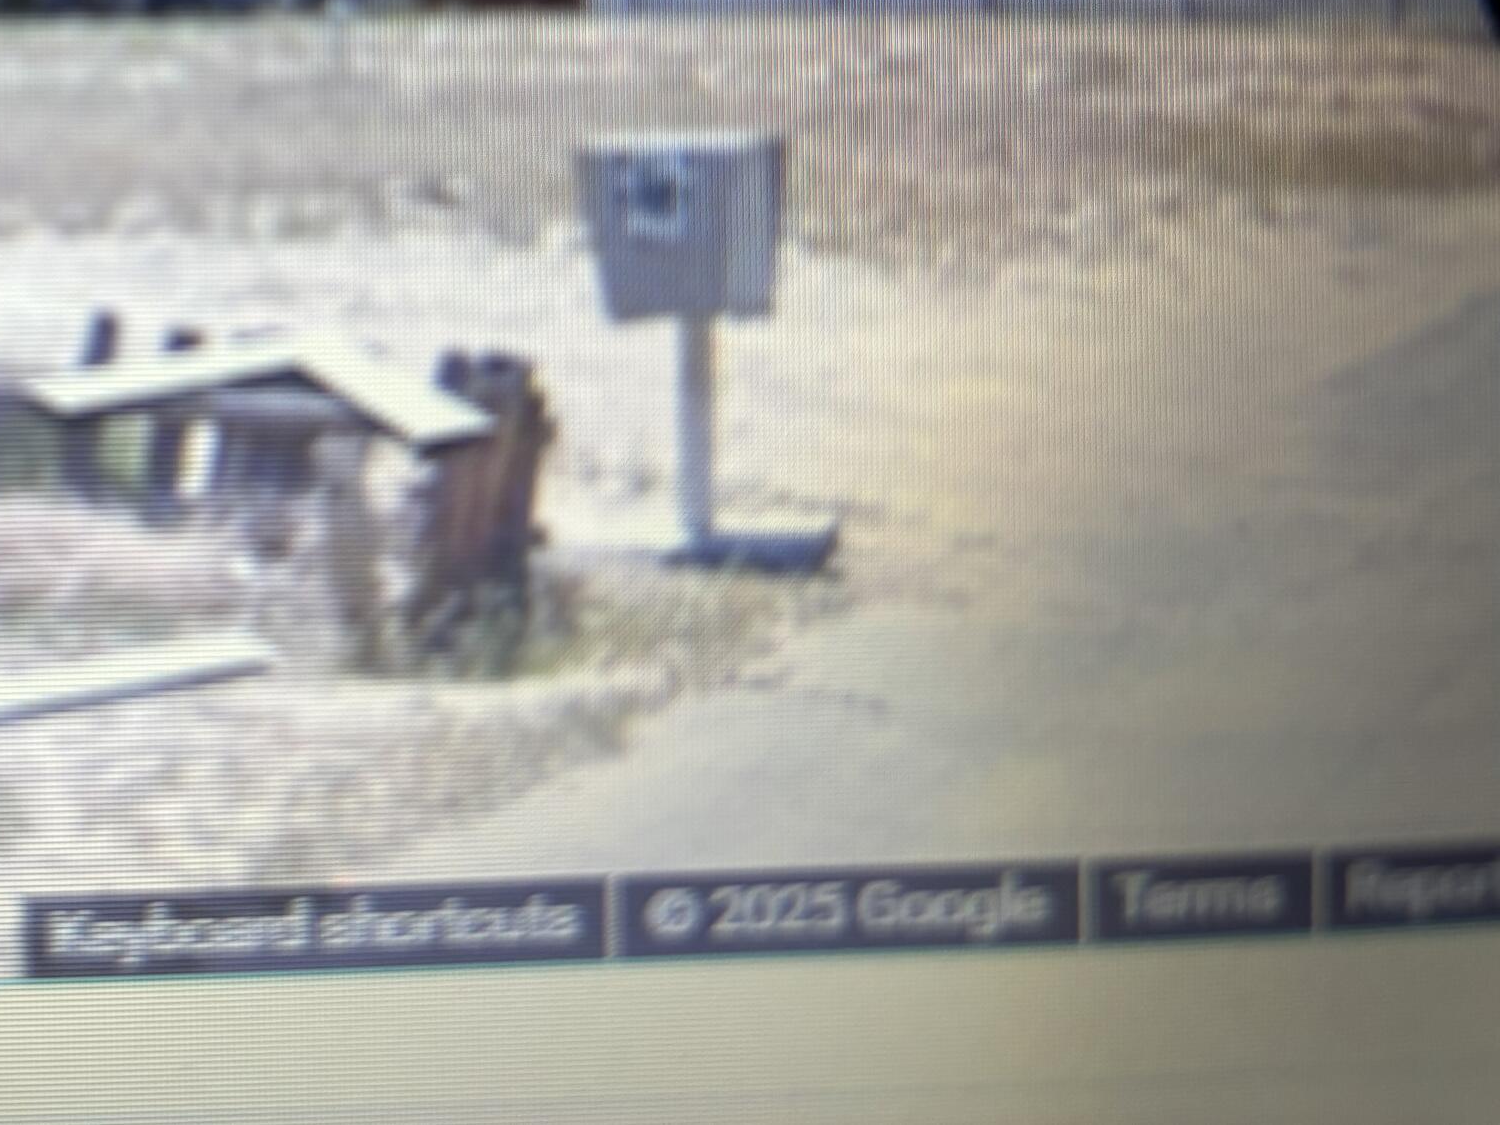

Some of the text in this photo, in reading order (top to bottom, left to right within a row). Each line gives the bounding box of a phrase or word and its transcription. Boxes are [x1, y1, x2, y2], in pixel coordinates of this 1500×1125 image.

[46, 892, 587, 971] Keyboard shortcuts
[707, 878, 848, 935] 2025
[856, 870, 1051, 942] Google
[1112, 871, 1286, 925] Terms
